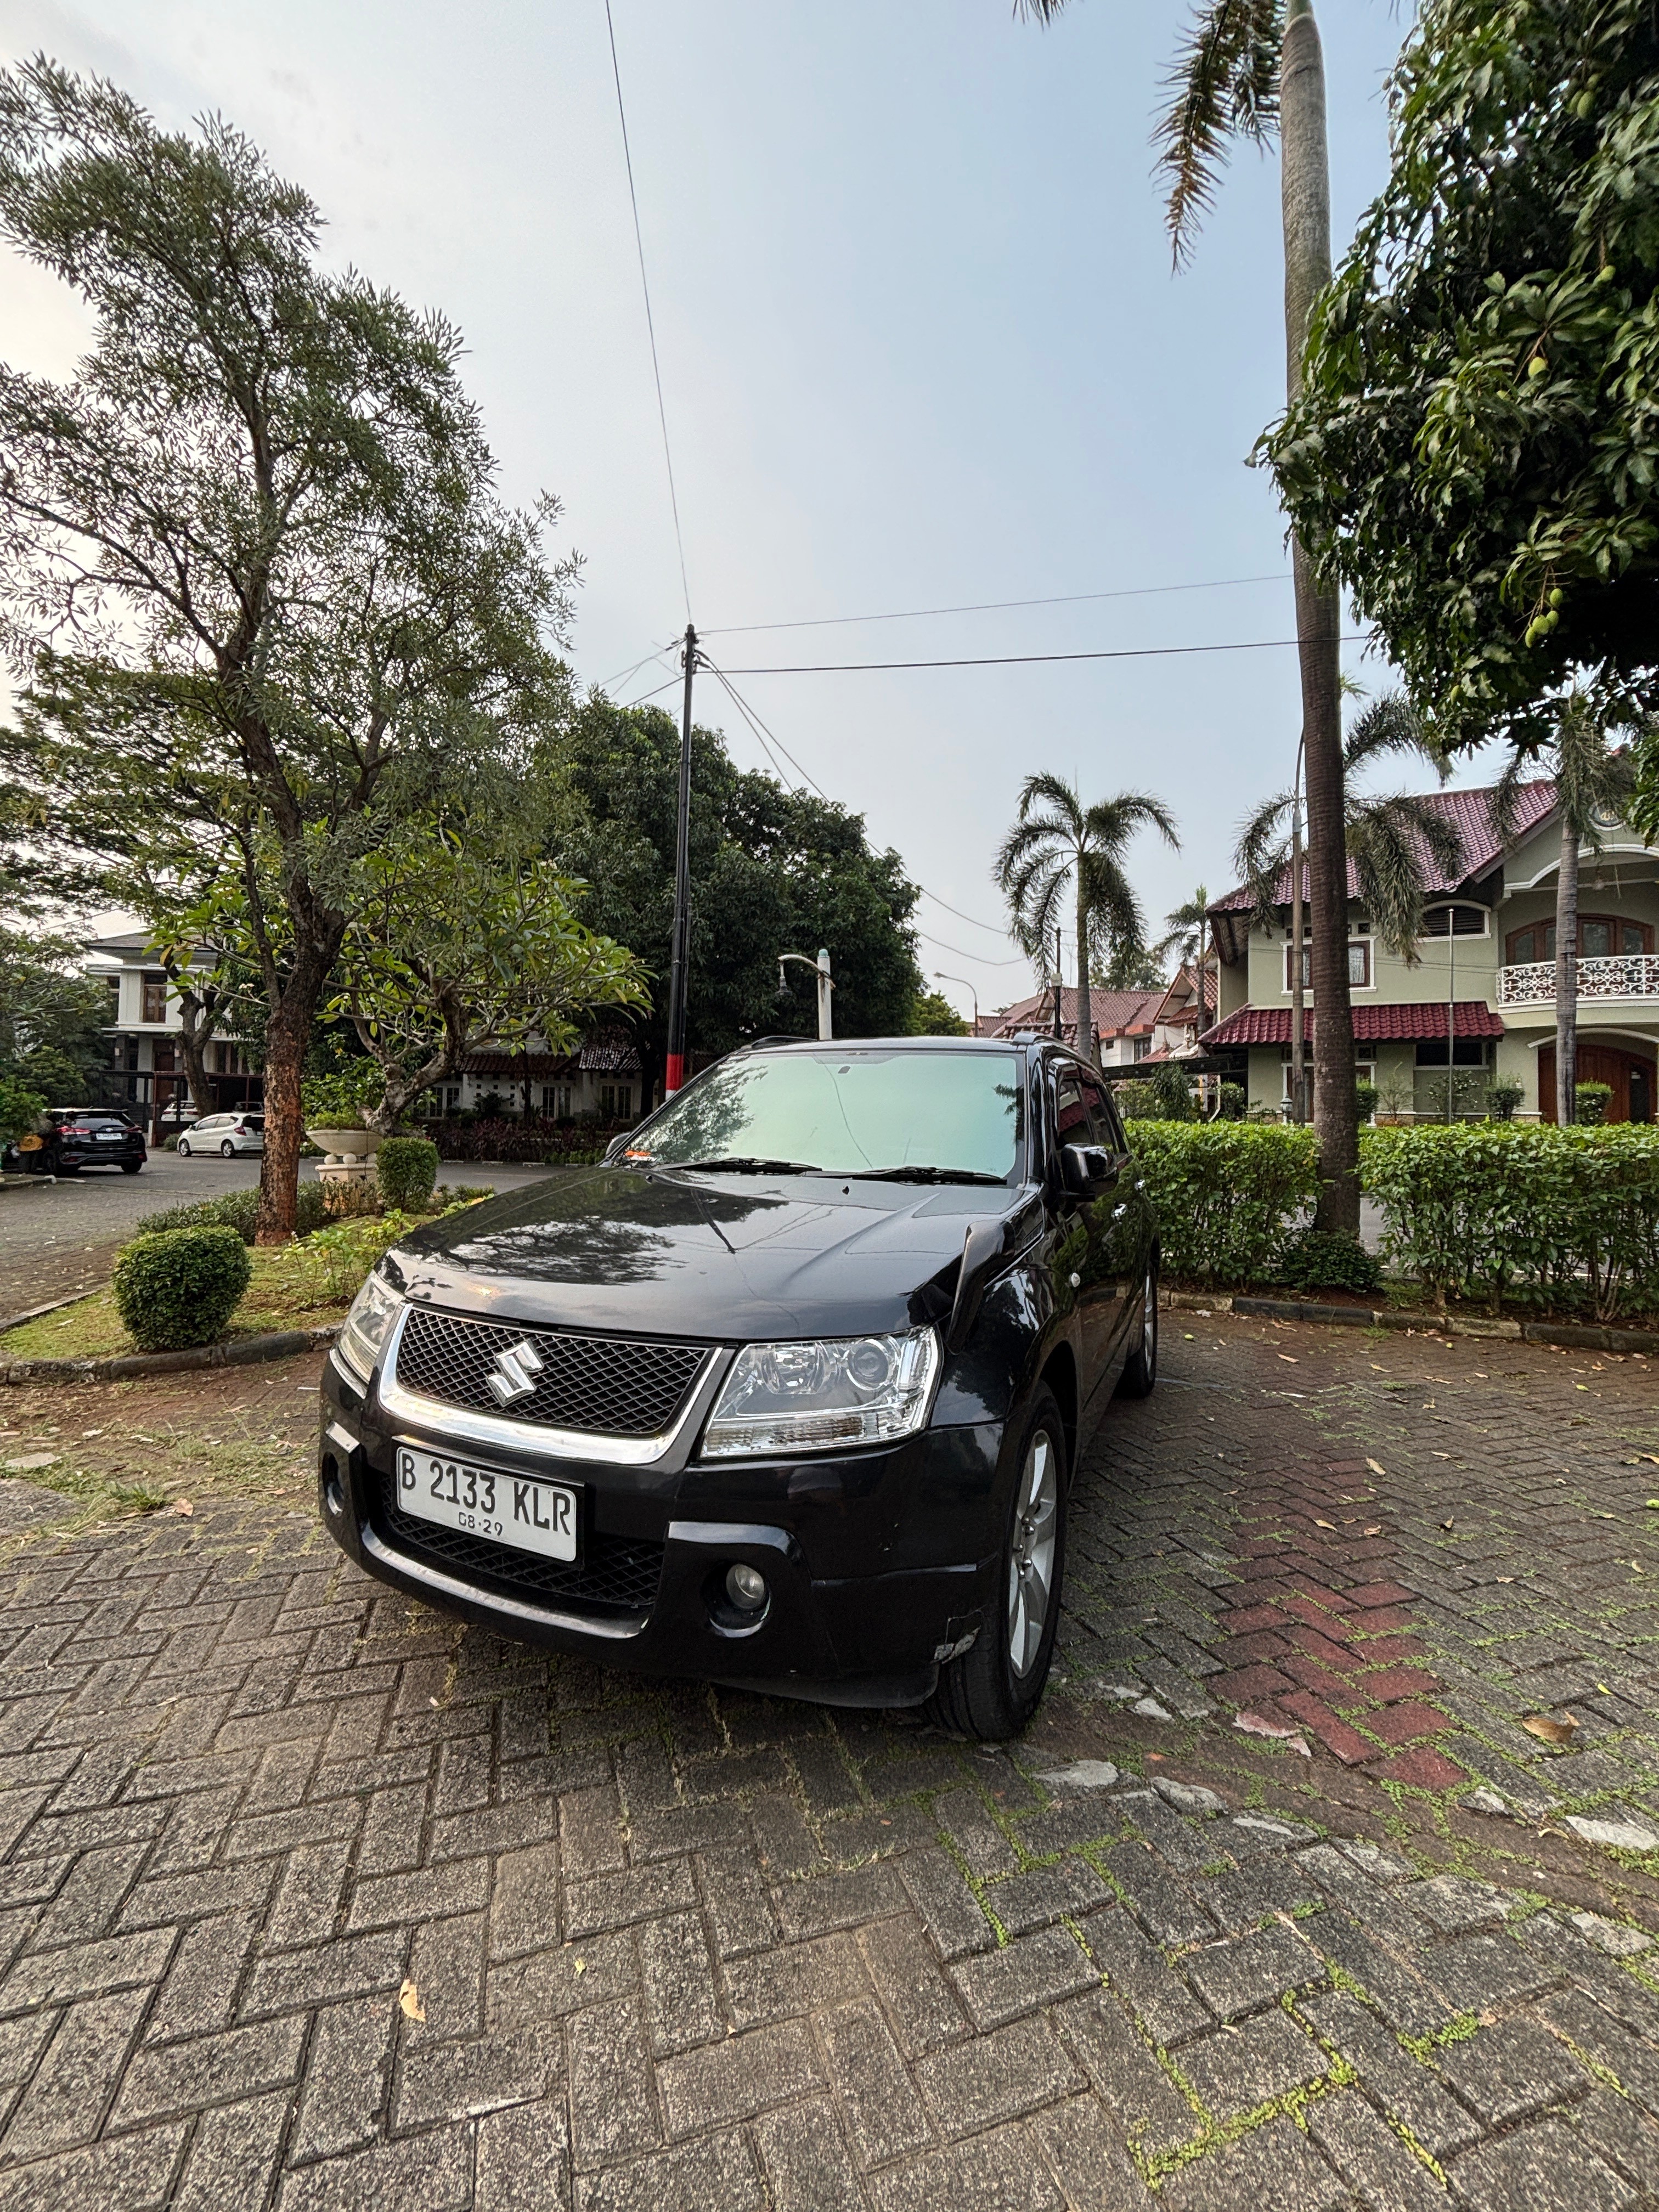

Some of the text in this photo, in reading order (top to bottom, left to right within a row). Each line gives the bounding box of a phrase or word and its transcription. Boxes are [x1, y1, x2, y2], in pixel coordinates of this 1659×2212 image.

[402, 1453, 571, 1536] B 2133 KLR
